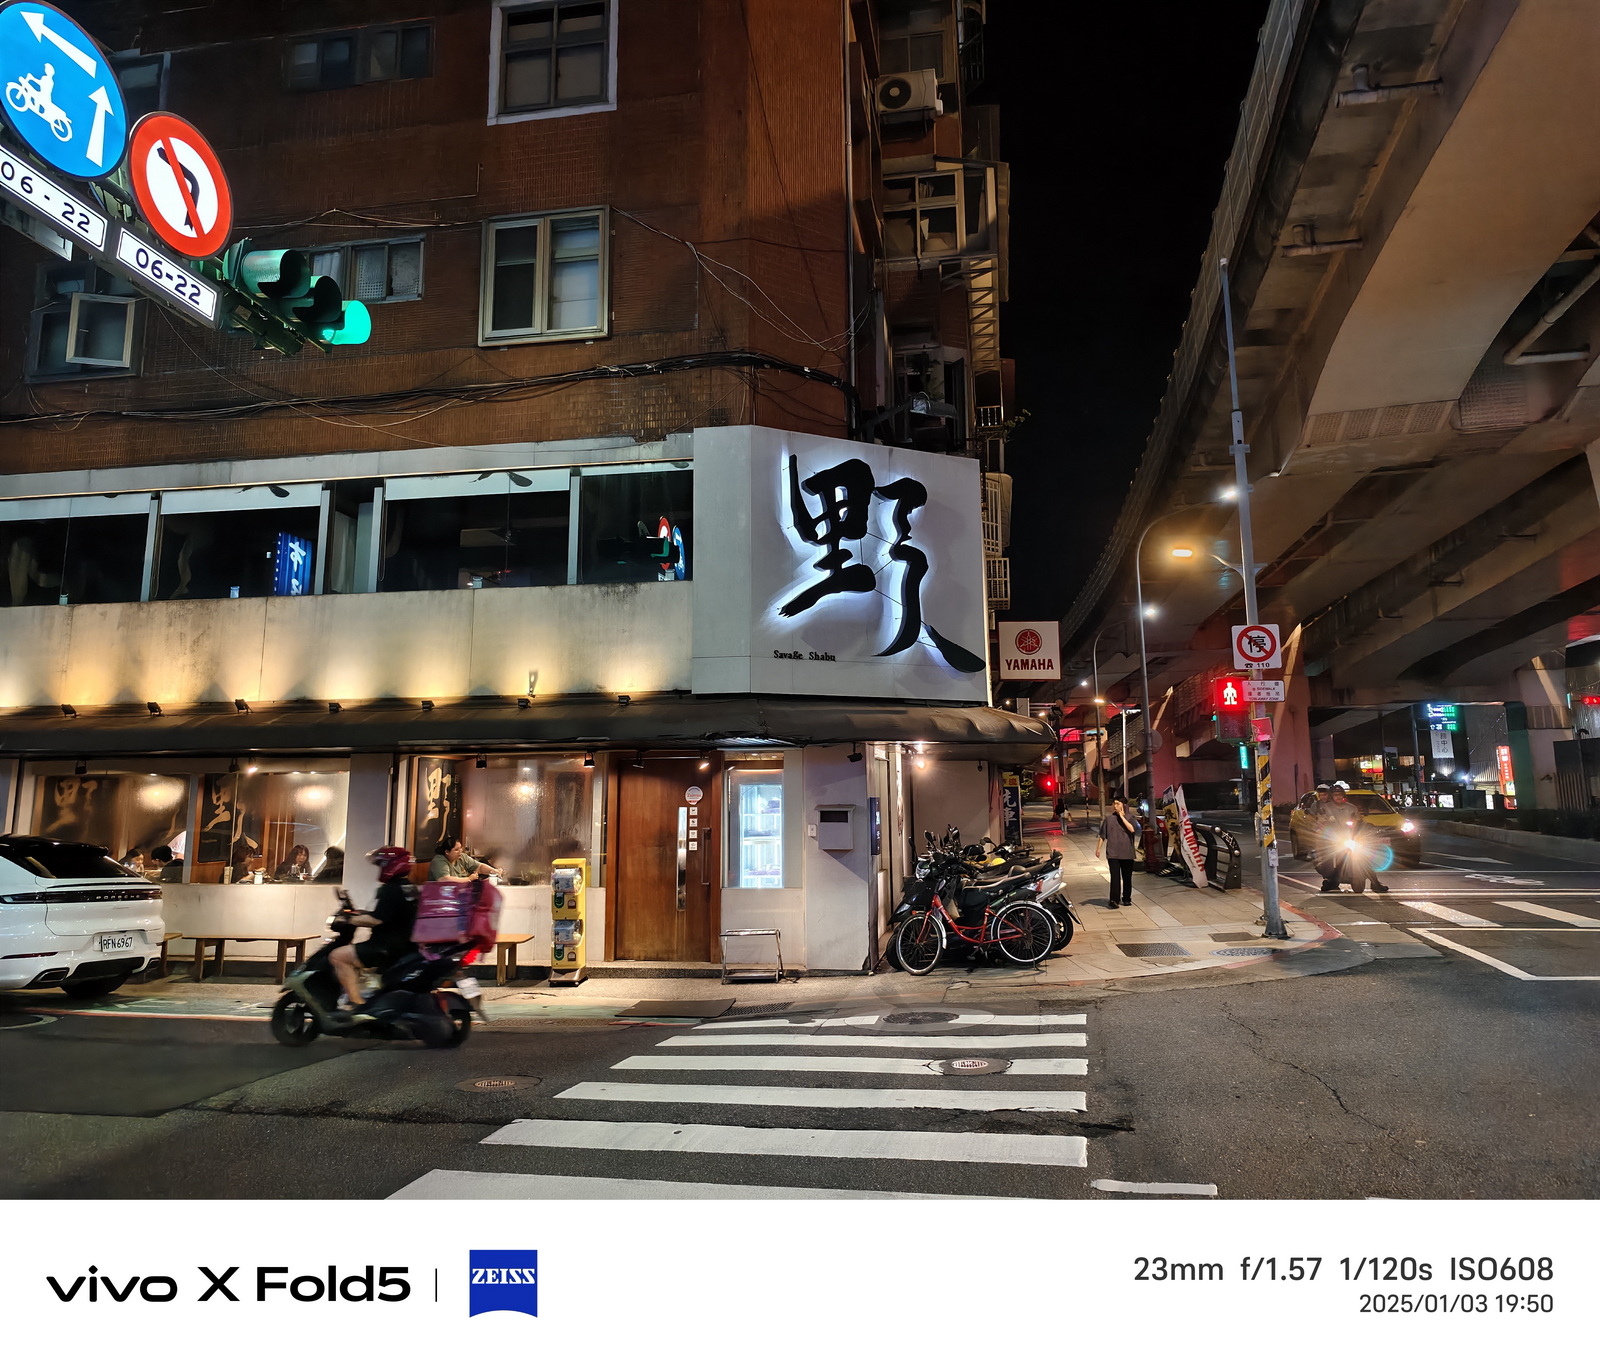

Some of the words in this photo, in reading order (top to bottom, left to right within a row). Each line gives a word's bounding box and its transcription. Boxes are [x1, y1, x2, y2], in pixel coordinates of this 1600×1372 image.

[135, 247, 201, 306] 06-22
[1248, 635, 1266, 653] 停
[773, 650, 804, 660] Savage
[808, 651, 836, 662] Shabu
[1005, 658, 1055, 671] YAMAHA
